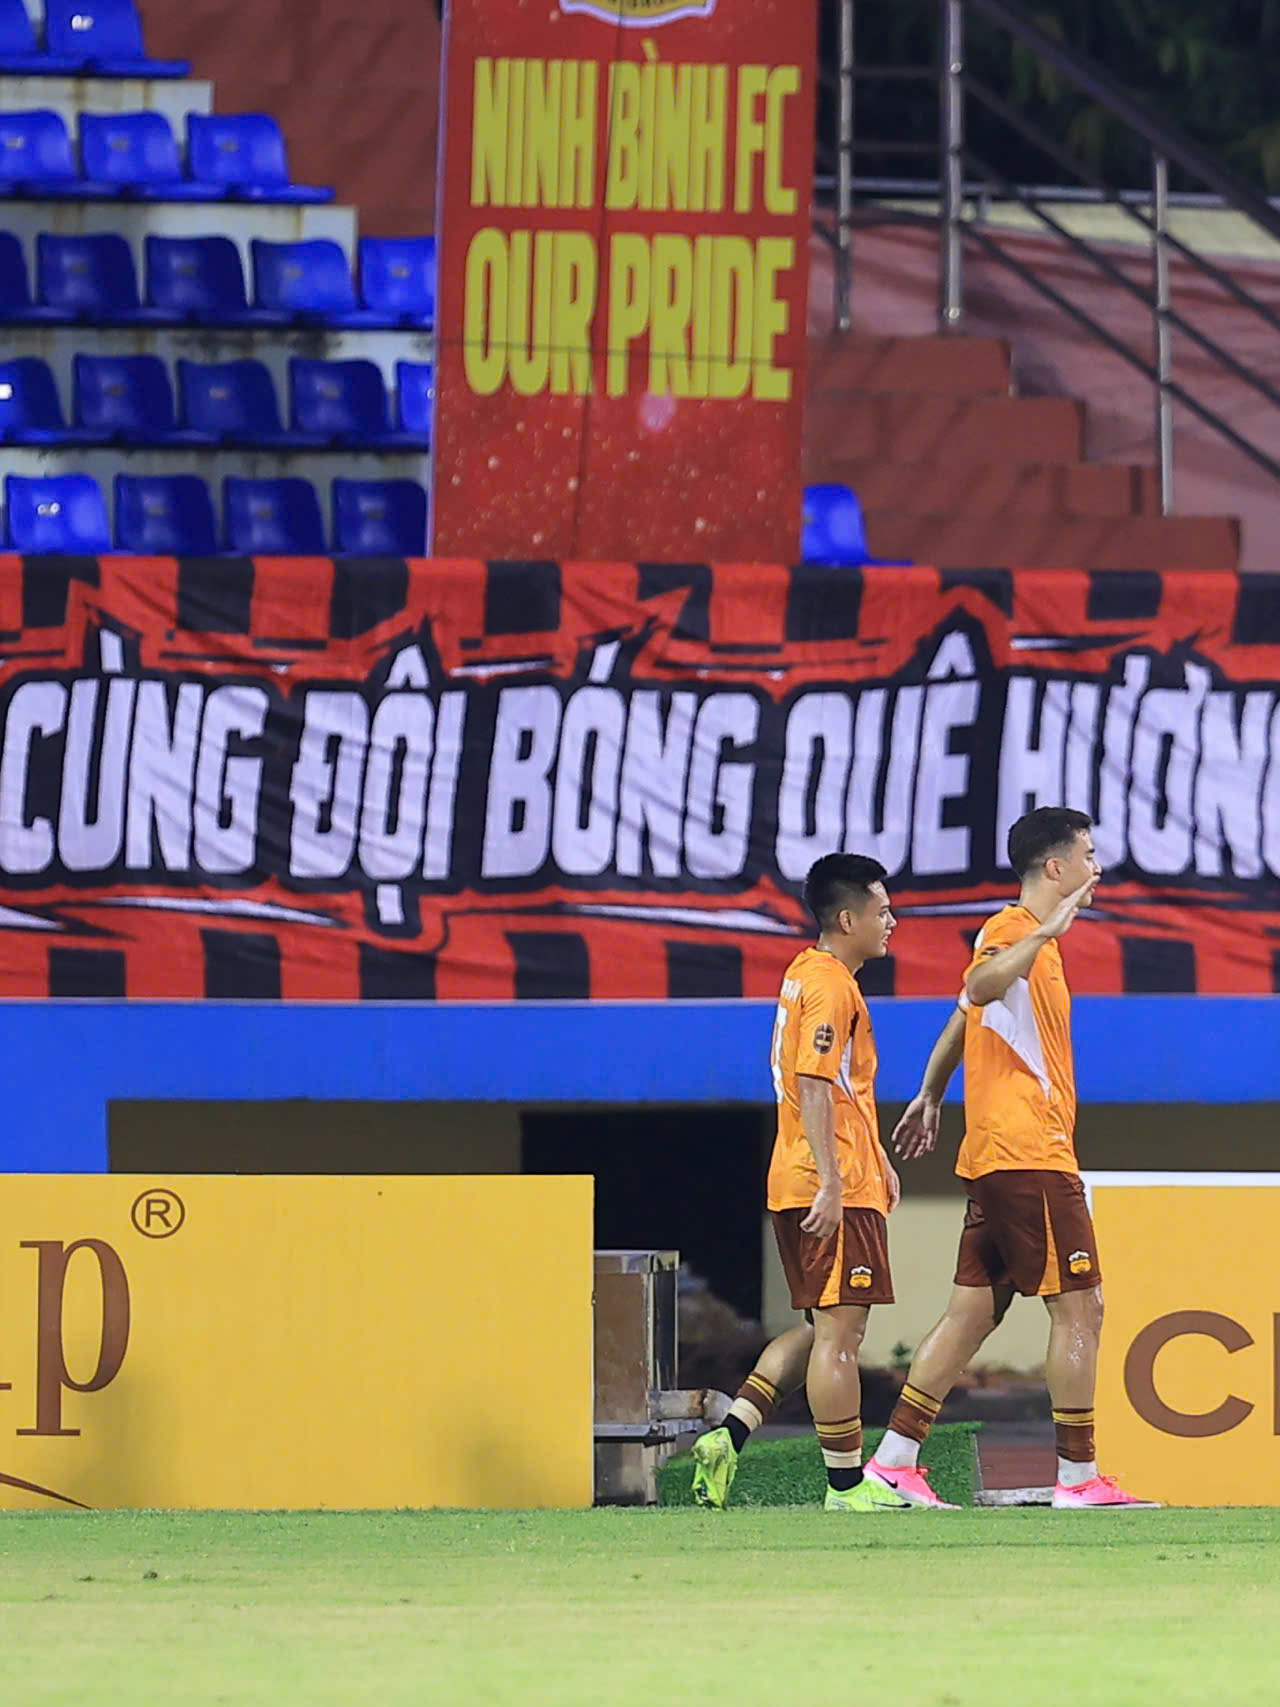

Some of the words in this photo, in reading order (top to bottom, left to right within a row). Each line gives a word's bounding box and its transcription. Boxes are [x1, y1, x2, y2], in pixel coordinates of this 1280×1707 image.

[470, 58, 598, 209] NINH
[606, 39, 728, 211] BÌNH
[735, 65, 801, 215] FC
[464, 226, 598, 396] OUR
[606, 233, 796, 402] PRIDE
[0, 628, 270, 875] CÙNG
[289, 643, 468, 926] ĐỘI
[481, 640, 762, 881] BÓNG
